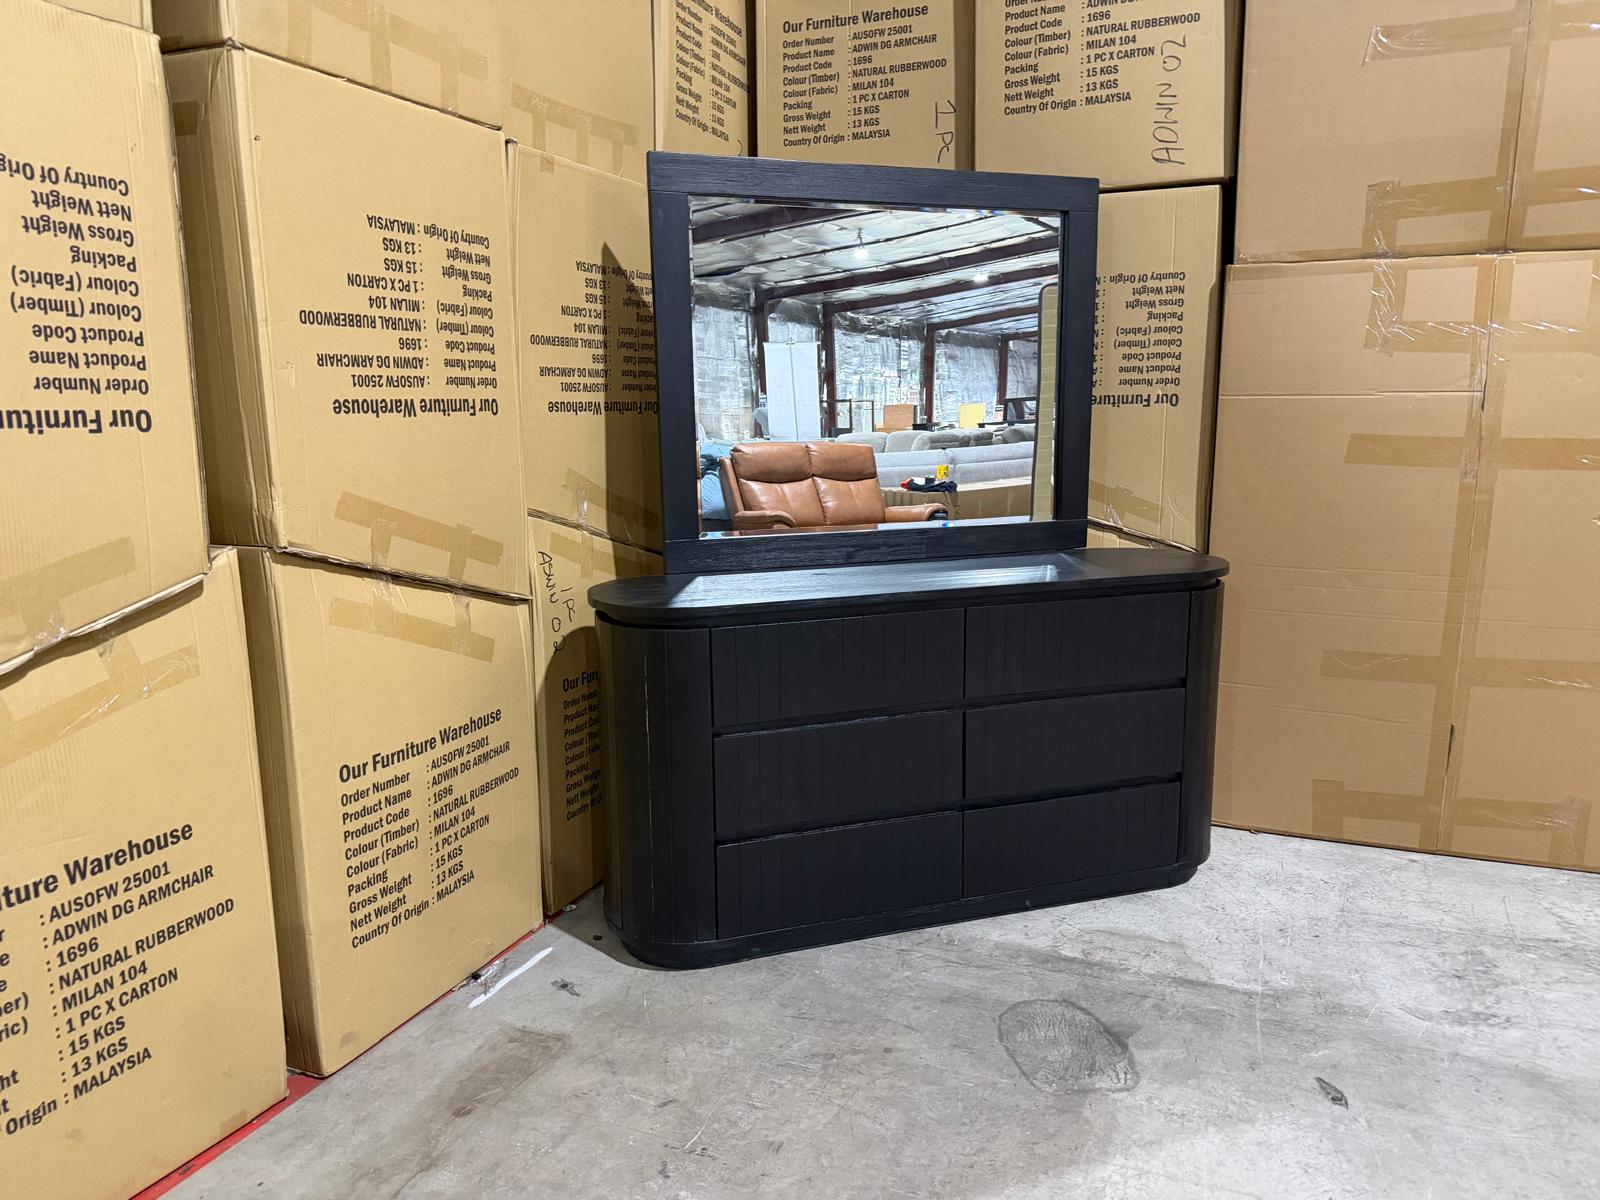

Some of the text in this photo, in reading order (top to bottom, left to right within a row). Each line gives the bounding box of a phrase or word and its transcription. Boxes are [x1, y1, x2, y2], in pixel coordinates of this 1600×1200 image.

[783, 5, 928, 33] Our Furniture Warehouse
[1005, 5, 1065, 21] Product Name
[1005, 10, 1110, 35] Product Code 1696
[850, 25, 912, 40] AUSOFW 25001
[1034, 13, 1199, 45] (Timber) NATURAL RUBBERWOOD
[850, 34, 936, 53] ADWIN ARMCHAIR
[1034, 35, 1136, 59] (Fabric) MILAN 104
[1160, 32, 1187, 72] 02
[809, 59, 945, 85] (Timber) NATURAL RUBBERWOOD
[853, 55, 872, 65] 1696
[1005, 46, 1154, 76] Packing CARTON
[852, 77, 894, 91] MILAN 104
[1030, 73, 1060, 85] Weight
[783, 89, 909, 114] Packing CARTON
[1004, 92, 1131, 116] Country Origin MALAYSIA
[1024, 88, 1053, 100] Weight
[864, 105, 880, 114] KGS
[852, 129, 890, 140] MALAYSIA
[40, 166, 129, 196] Country Of
[31, 188, 131, 222] Nett Weight
[21, 214, 134, 247] Gross Weight
[367, 214, 489, 249] Country Origin MALAYSIA
[70, 245, 136, 272] Packing
[576, 261, 606, 276] MALAYSIA
[12, 265, 139, 297] Colour (Fabric)
[442, 265, 469, 282] Weight
[1110, 270, 1185, 284] Country Origin
[347, 273, 492, 302] Packing CARTON
[11, 292, 141, 322] Colour (Timber)
[390, 298, 469, 317] (Fabric) MILAN
[561, 305, 588, 317] CARTON
[1125, 299, 1158, 309] Weight
[299, 310, 470, 335] (Timber) NATURAL RUBBERWOOD
[1147, 311, 1183, 322] Packing
[32, 324, 144, 346] Product Code
[530, 335, 578, 347] RUBBERWOOD
[1116, 325, 1151, 336] (Fabric)
[399, 337, 495, 355] Product Code 1696
[1114, 338, 1150, 349] (Timber)
[29, 351, 146, 371] Product Name
[317, 353, 496, 372] Product Name ADWIN ARMCHAIR
[1119, 364, 1181, 374] Product Name
[1122, 353, 1144, 361] Code
[351, 375, 477, 388] Number AUSOFW 25001
[539, 366, 609, 380] ADWIN ARMCHAIR
[1118, 378, 1153, 387] Number
[34, 377, 149, 395] Order Number
[560, 382, 608, 393] AUSOFW 25001
[333, 399, 498, 418] Our Furniture Warehouse
[548, 401, 602, 415] Warehouse
[1154, 393, 1179, 407] Our
[109, 410, 152, 433] Our
[563, 674, 579, 692] Our
[339, 707, 501, 783] Our Furniture Warehouse
[341, 735, 489, 807] Order Number AUSOFW 25001
[343, 741, 510, 825] Product Name ADWIN ARMCHAIR
[566, 762, 589, 780] Packing
[344, 785, 453, 843] Product Code 1696
[345, 767, 518, 860] Colour (Timber) NATURAL RUBBERWOOD
[567, 803, 589, 822] Country
[382, 815, 459, 865] (Fabric) MILAN
[64, 821, 192, 885] Warehouse
[348, 814, 489, 898] Packing CARTON
[48, 881, 118, 923] AUSOFW
[122, 861, 169, 893] 25001
[350, 874, 412, 913] Gross Weight
[51, 865, 213, 945] ADWIN DG ARMCHAIR
[352, 870, 474, 952] Country Origin MALAYSIA
[371, 894, 406, 921] Weight
[55, 937, 98, 967] 1696
[58, 899, 233, 990] NATURAL RUBBERWOOD
[62, 960, 146, 1012] MILAN 104
[118, 968, 177, 1006] CARTON
[93, 1016, 125, 1044] KGS
[96, 1037, 128, 1065] KGS
[6, 1098, 57, 1140] Origin
[74, 1047, 151, 1099] MALAYSIA
